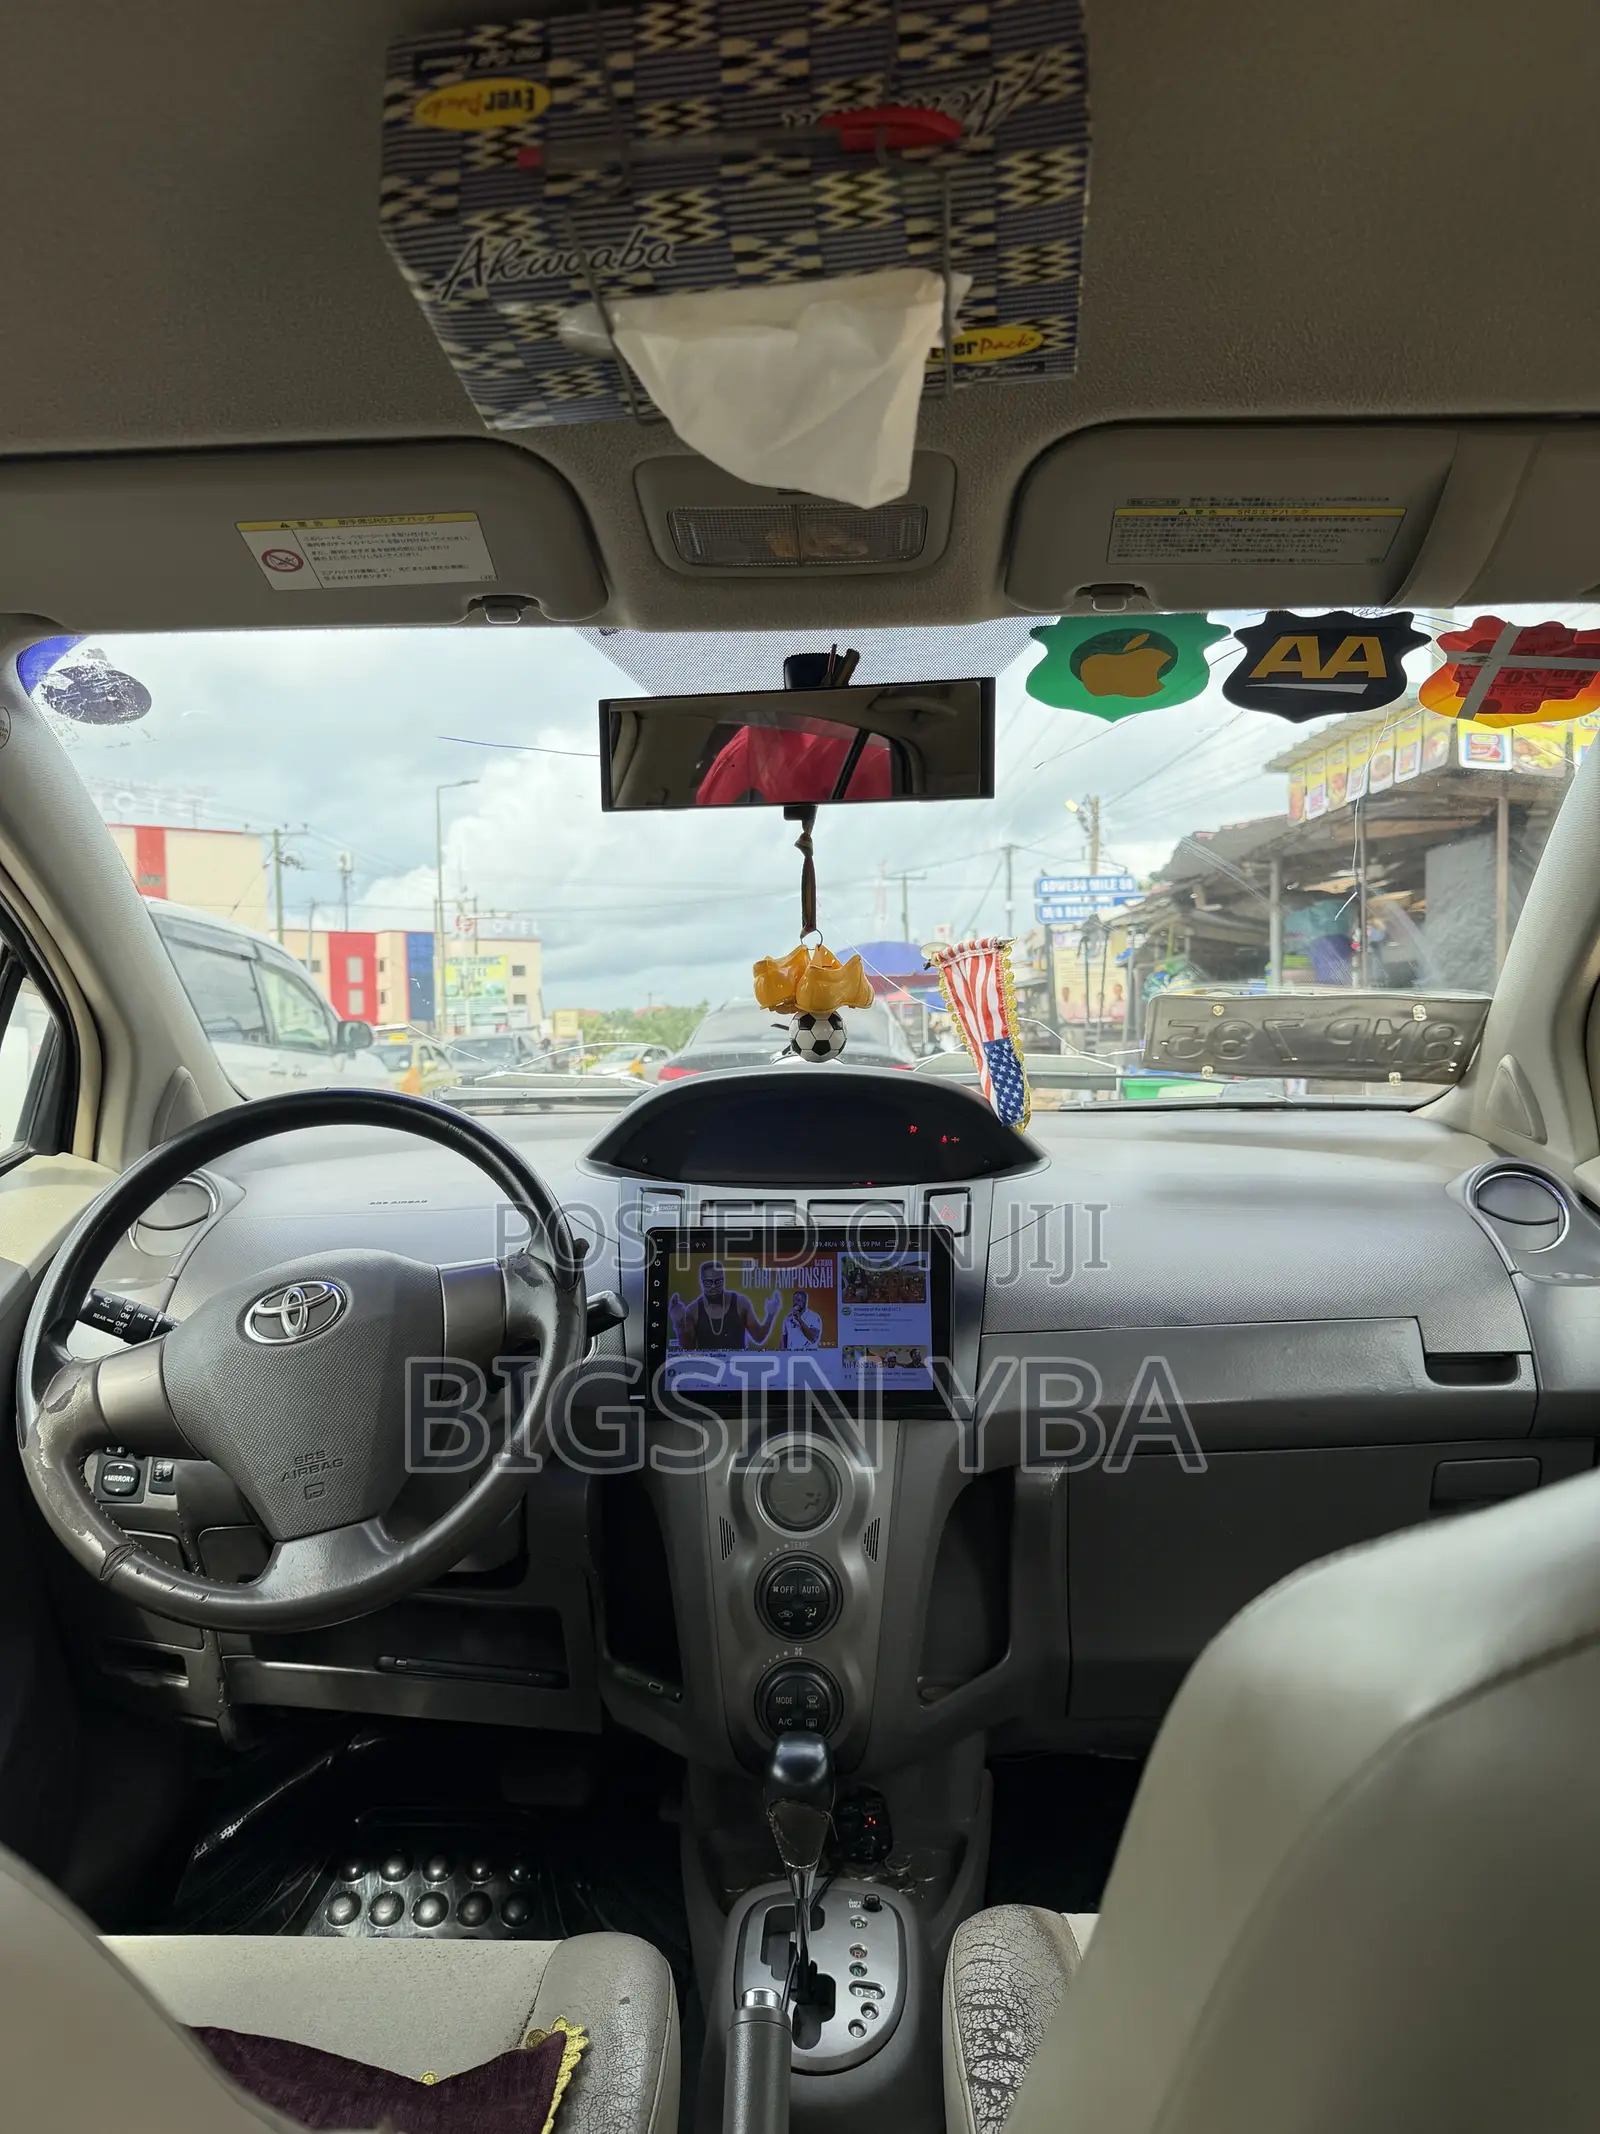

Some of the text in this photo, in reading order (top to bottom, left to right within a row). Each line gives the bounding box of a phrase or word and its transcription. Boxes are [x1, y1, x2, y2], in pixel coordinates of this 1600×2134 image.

[440, 225, 676, 301] Akwaaba
[979, 334, 1031, 356] Pack
[1248, 636, 1388, 679] AA
[774, 1267, 834, 1289] AMPONSAH
[92, 1312, 107, 1322] REAR
[120, 1312, 130, 1320] ON
[137, 1312, 149, 1321] INT
[114, 1320, 128, 1329] OFF
[281, 1458, 344, 1482] AIRBAG
[108, 1475, 131, 1483] MIRROR
[789, 1541, 811, 1549] TEMP
[780, 1585, 794, 1594] OFF
[801, 1586, 820, 1594] AUTO
[775, 1696, 793, 1705] MODE
[778, 1717, 793, 1726] A/C
